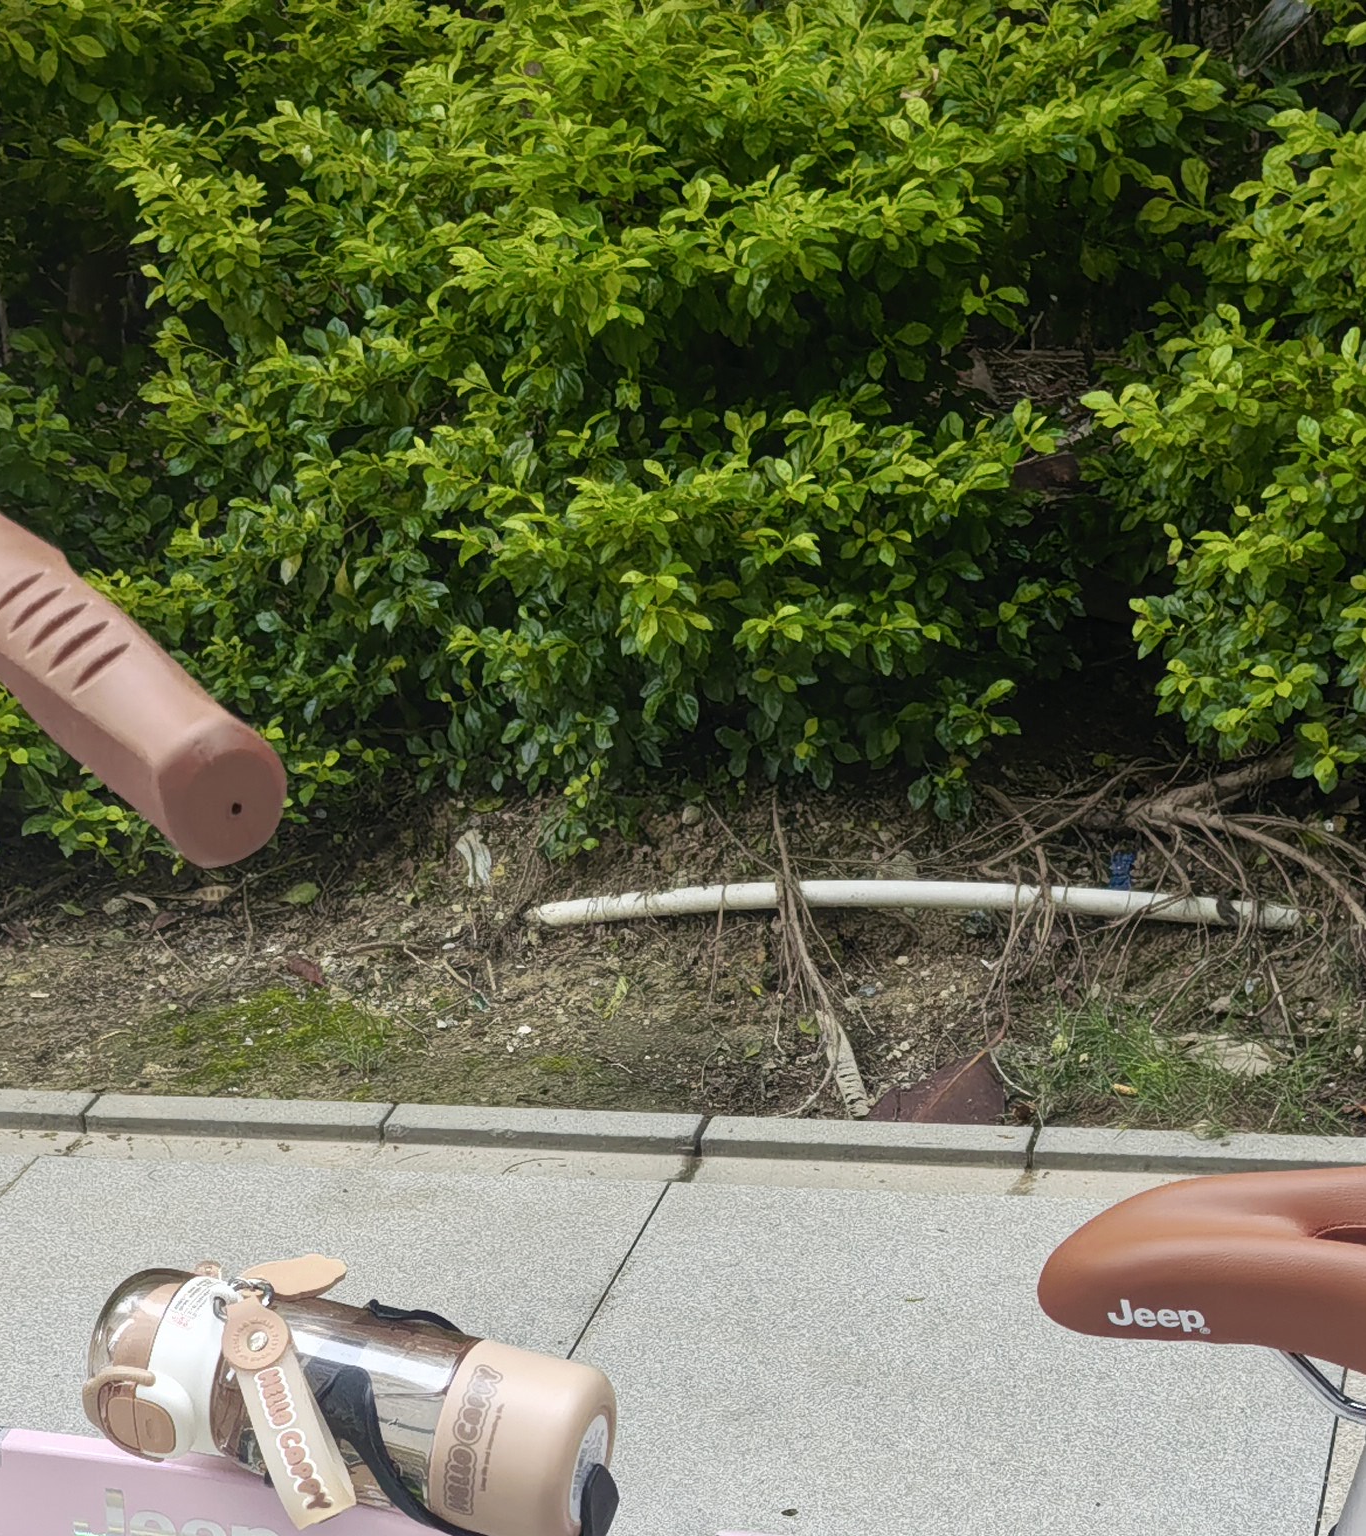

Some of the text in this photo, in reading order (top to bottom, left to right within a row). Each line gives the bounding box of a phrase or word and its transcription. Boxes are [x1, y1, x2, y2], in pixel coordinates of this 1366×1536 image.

[1107, 1298, 1207, 1333] Jeep
[444, 1364, 503, 1515] HELLO CAPPY
